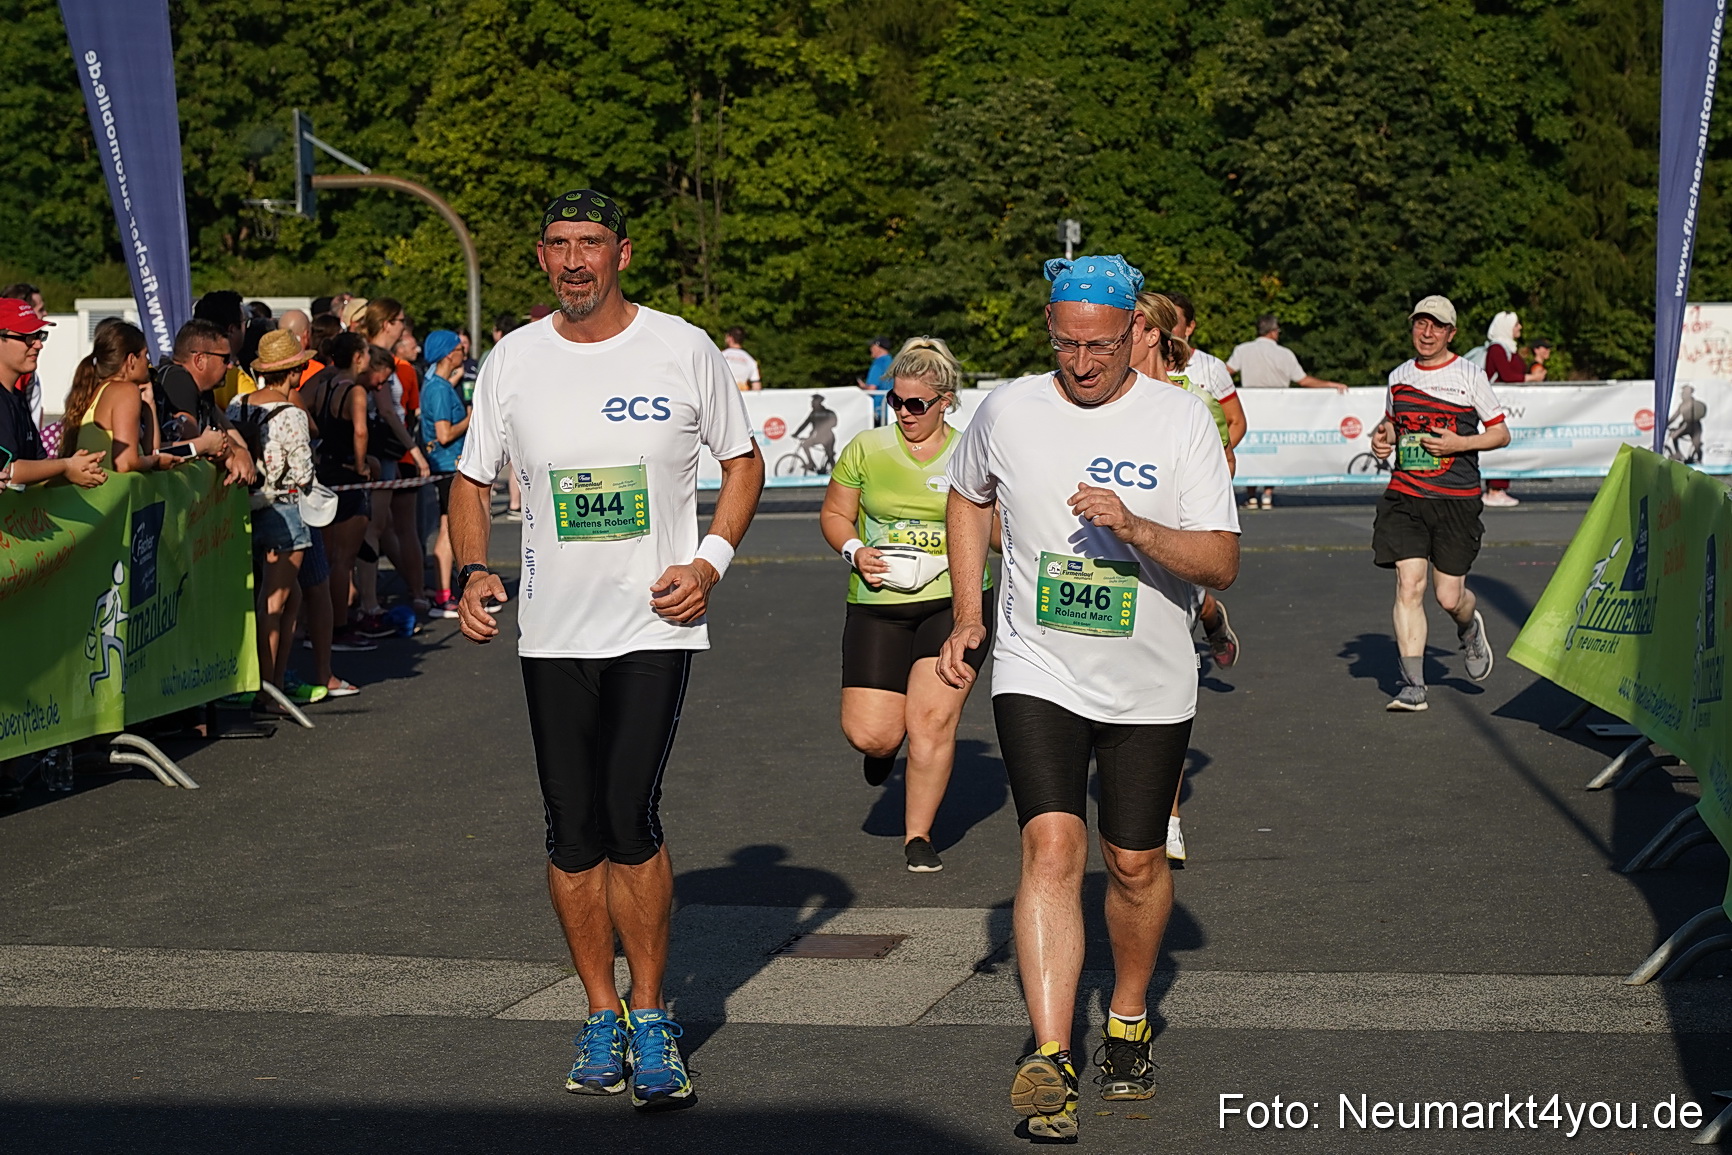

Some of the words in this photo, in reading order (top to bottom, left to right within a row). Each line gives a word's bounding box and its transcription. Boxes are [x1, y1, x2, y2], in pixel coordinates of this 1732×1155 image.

[601, 396, 672, 422] ecs
[1086, 457, 1158, 490] ecs
[559, 502, 569, 527] RUN
[575, 492, 625, 518] 944
[634, 493, 645, 527] 2022
[569, 520, 602, 528] Mertens
[604, 517, 635, 527] Robert
[906, 531, 942, 548] 335
[1041, 586, 1050, 612] RUN
[1059, 581, 1112, 611] 946
[1120, 592, 1132, 626] 2022
[1055, 606, 1087, 620] Roland
[1089, 612, 1113, 622] Marc
[1577, 635, 1620, 654] neumarkt
